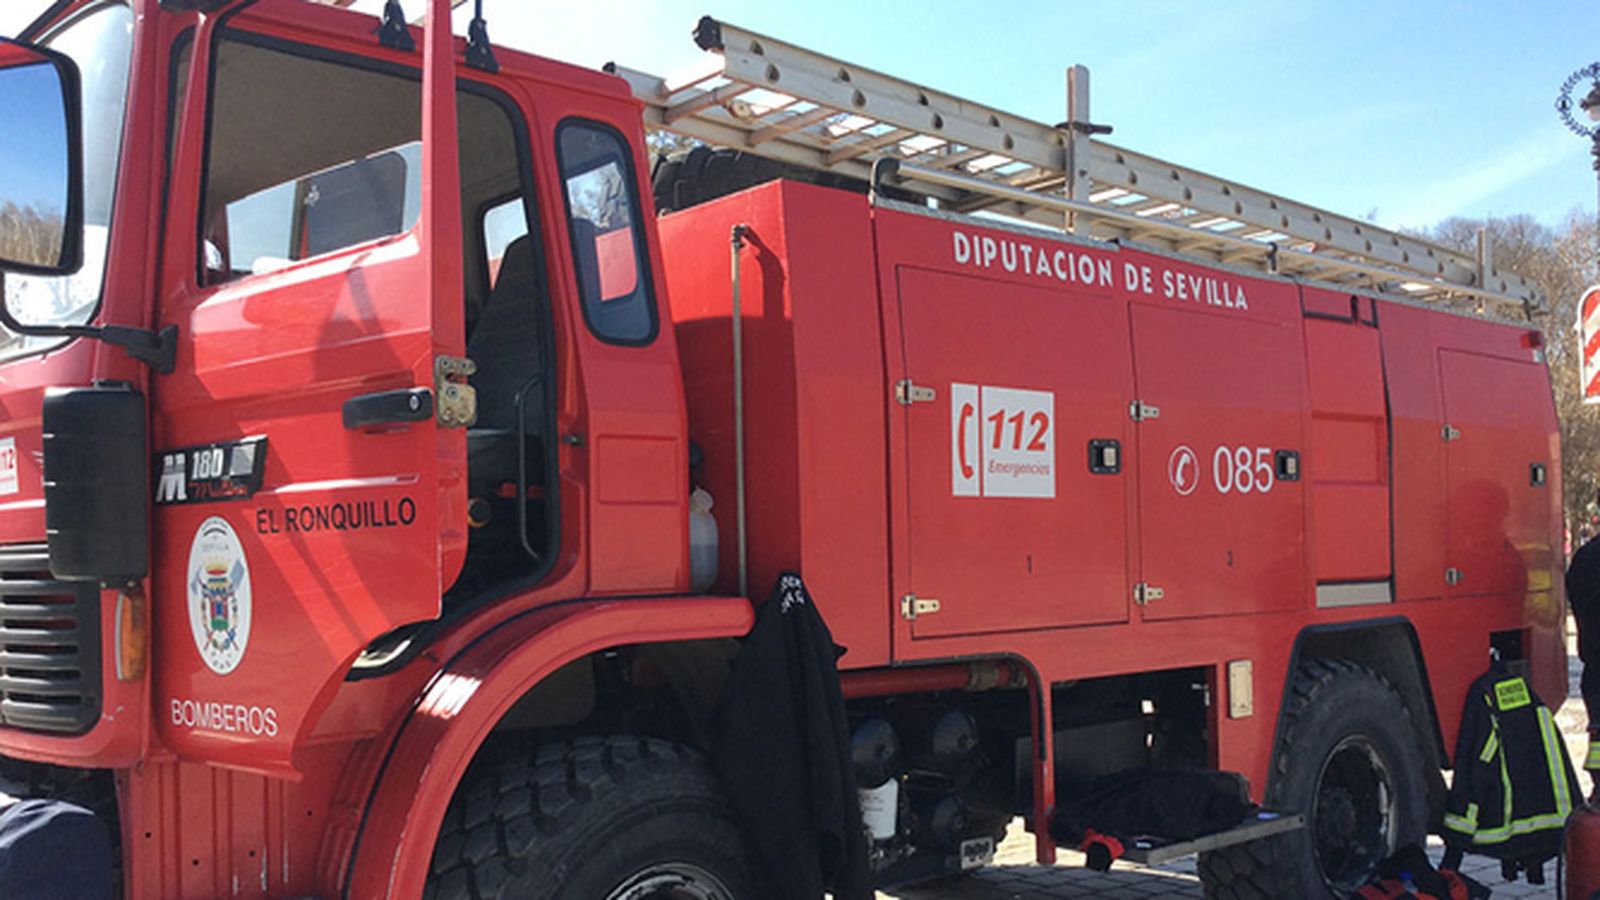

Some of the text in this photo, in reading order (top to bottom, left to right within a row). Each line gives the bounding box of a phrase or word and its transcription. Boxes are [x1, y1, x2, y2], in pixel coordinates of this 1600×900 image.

[953, 231, 1248, 310] DIPUTACION DE SEVILLA
[987, 408, 1050, 453] 112
[191, 447, 225, 480] 180
[1213, 446, 1274, 494] 085
[256, 508, 279, 534] EL
[285, 497, 416, 533] RONQUILLO
[171, 698, 279, 737] BOMBEROS
